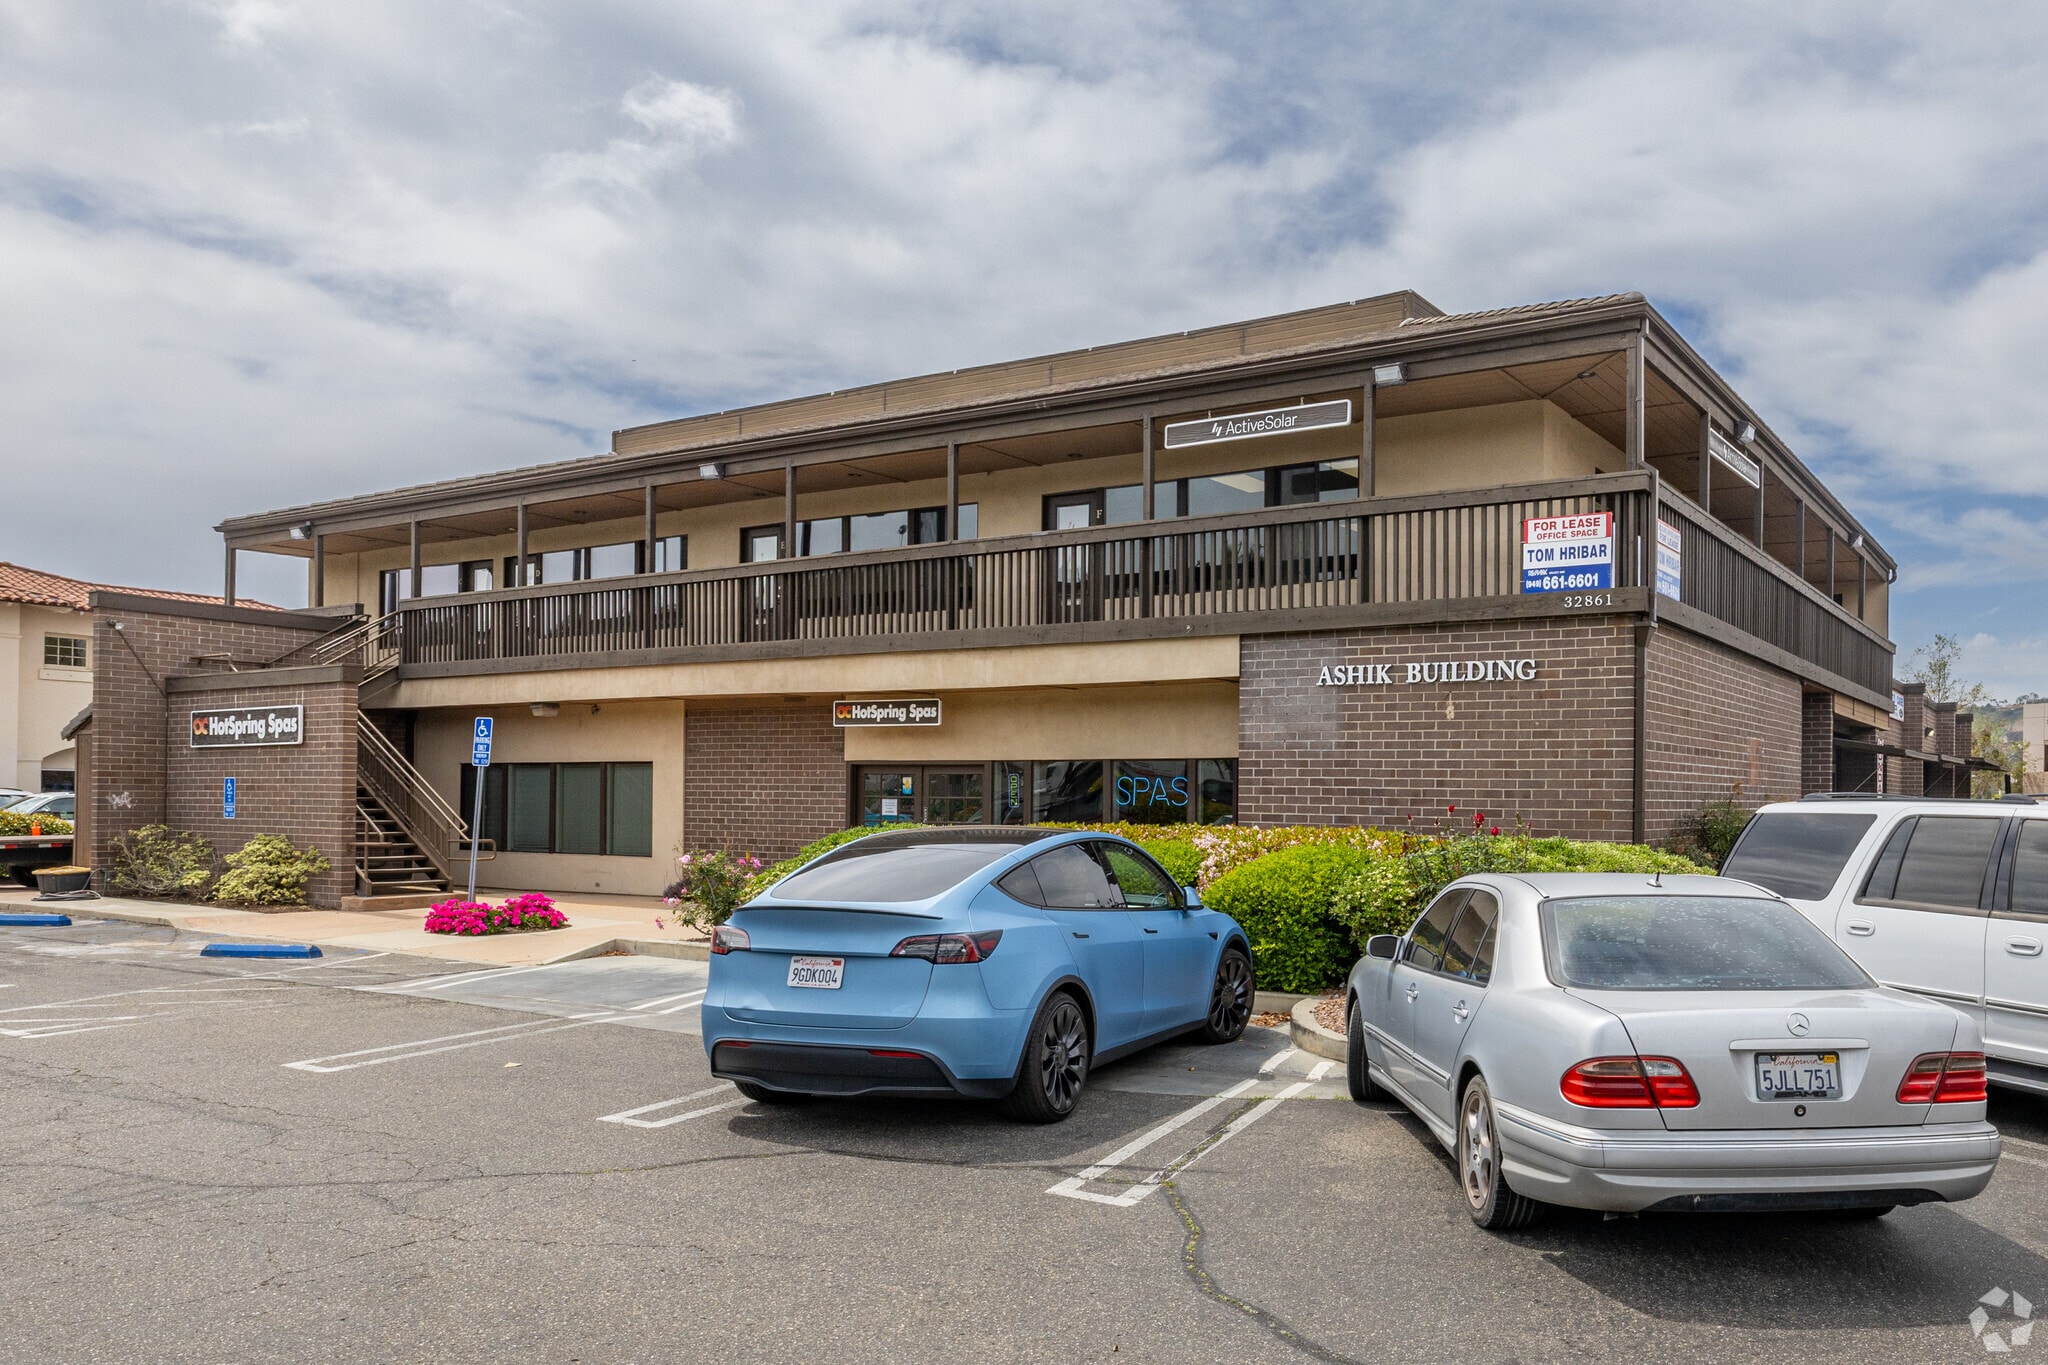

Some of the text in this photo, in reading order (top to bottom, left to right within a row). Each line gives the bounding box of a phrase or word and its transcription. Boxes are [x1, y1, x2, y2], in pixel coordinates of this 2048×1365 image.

[1225, 415, 1298, 435] ActiveSolar
[1534, 517, 1601, 531] FOR LEASE
[1536, 528, 1598, 540] OFFICE SPACE
[1527, 543, 1607, 562] TOM HRIBAR
[1525, 579, 1542, 589] (949)
[1564, 594, 1612, 608] 32861
[1316, 659, 1537, 686] ASHIK BUILDING
[852, 704, 907, 722] HotSpring
[909, 704, 937, 722] Spas
[209, 714, 266, 740] HotSpring
[268, 713, 297, 739] Spas
[1010, 776, 1018, 806] OPEN
[1116, 776, 1188, 806] SPAS
[791, 967, 838, 984] 9GDK004
[1773, 1056, 1818, 1069] California
[1762, 1069, 1836, 1091] 5JLL751
